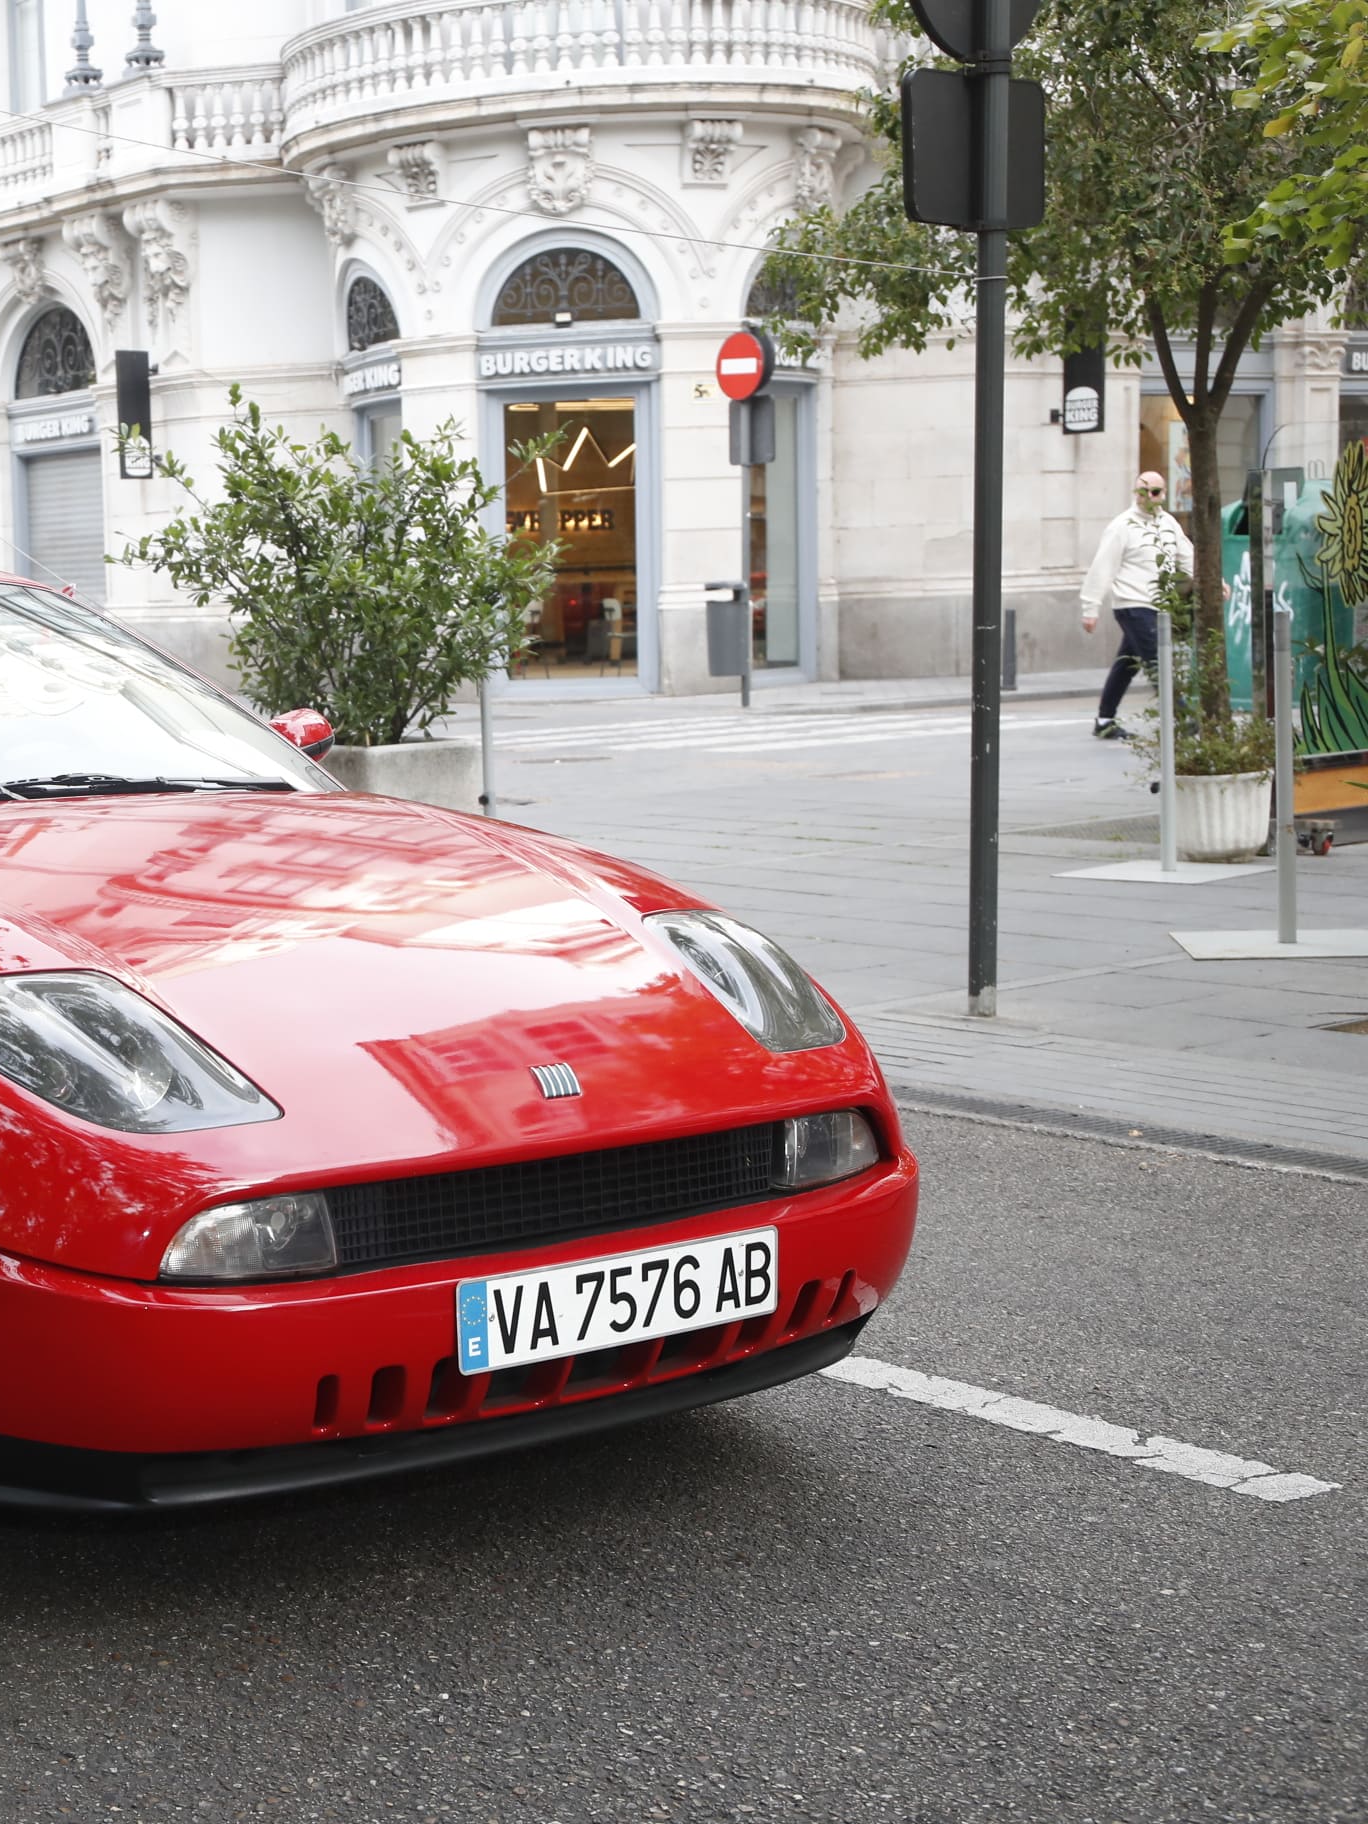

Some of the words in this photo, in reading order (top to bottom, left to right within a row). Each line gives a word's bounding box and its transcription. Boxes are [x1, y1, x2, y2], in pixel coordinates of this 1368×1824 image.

[480, 348, 582, 377] BURGER
[584, 345, 653, 370] KING
[364, 363, 400, 389] KING
[1065, 408, 1099, 422] KING
[17, 420, 60, 443] BURGER
[60, 415, 91, 437] KING
[506, 509, 615, 531] WHPPER
[493, 1281, 559, 1355] VA
[576, 1254, 701, 1342] 7576
[715, 1241, 771, 1313] AB
[468, 1336, 481, 1357] E
